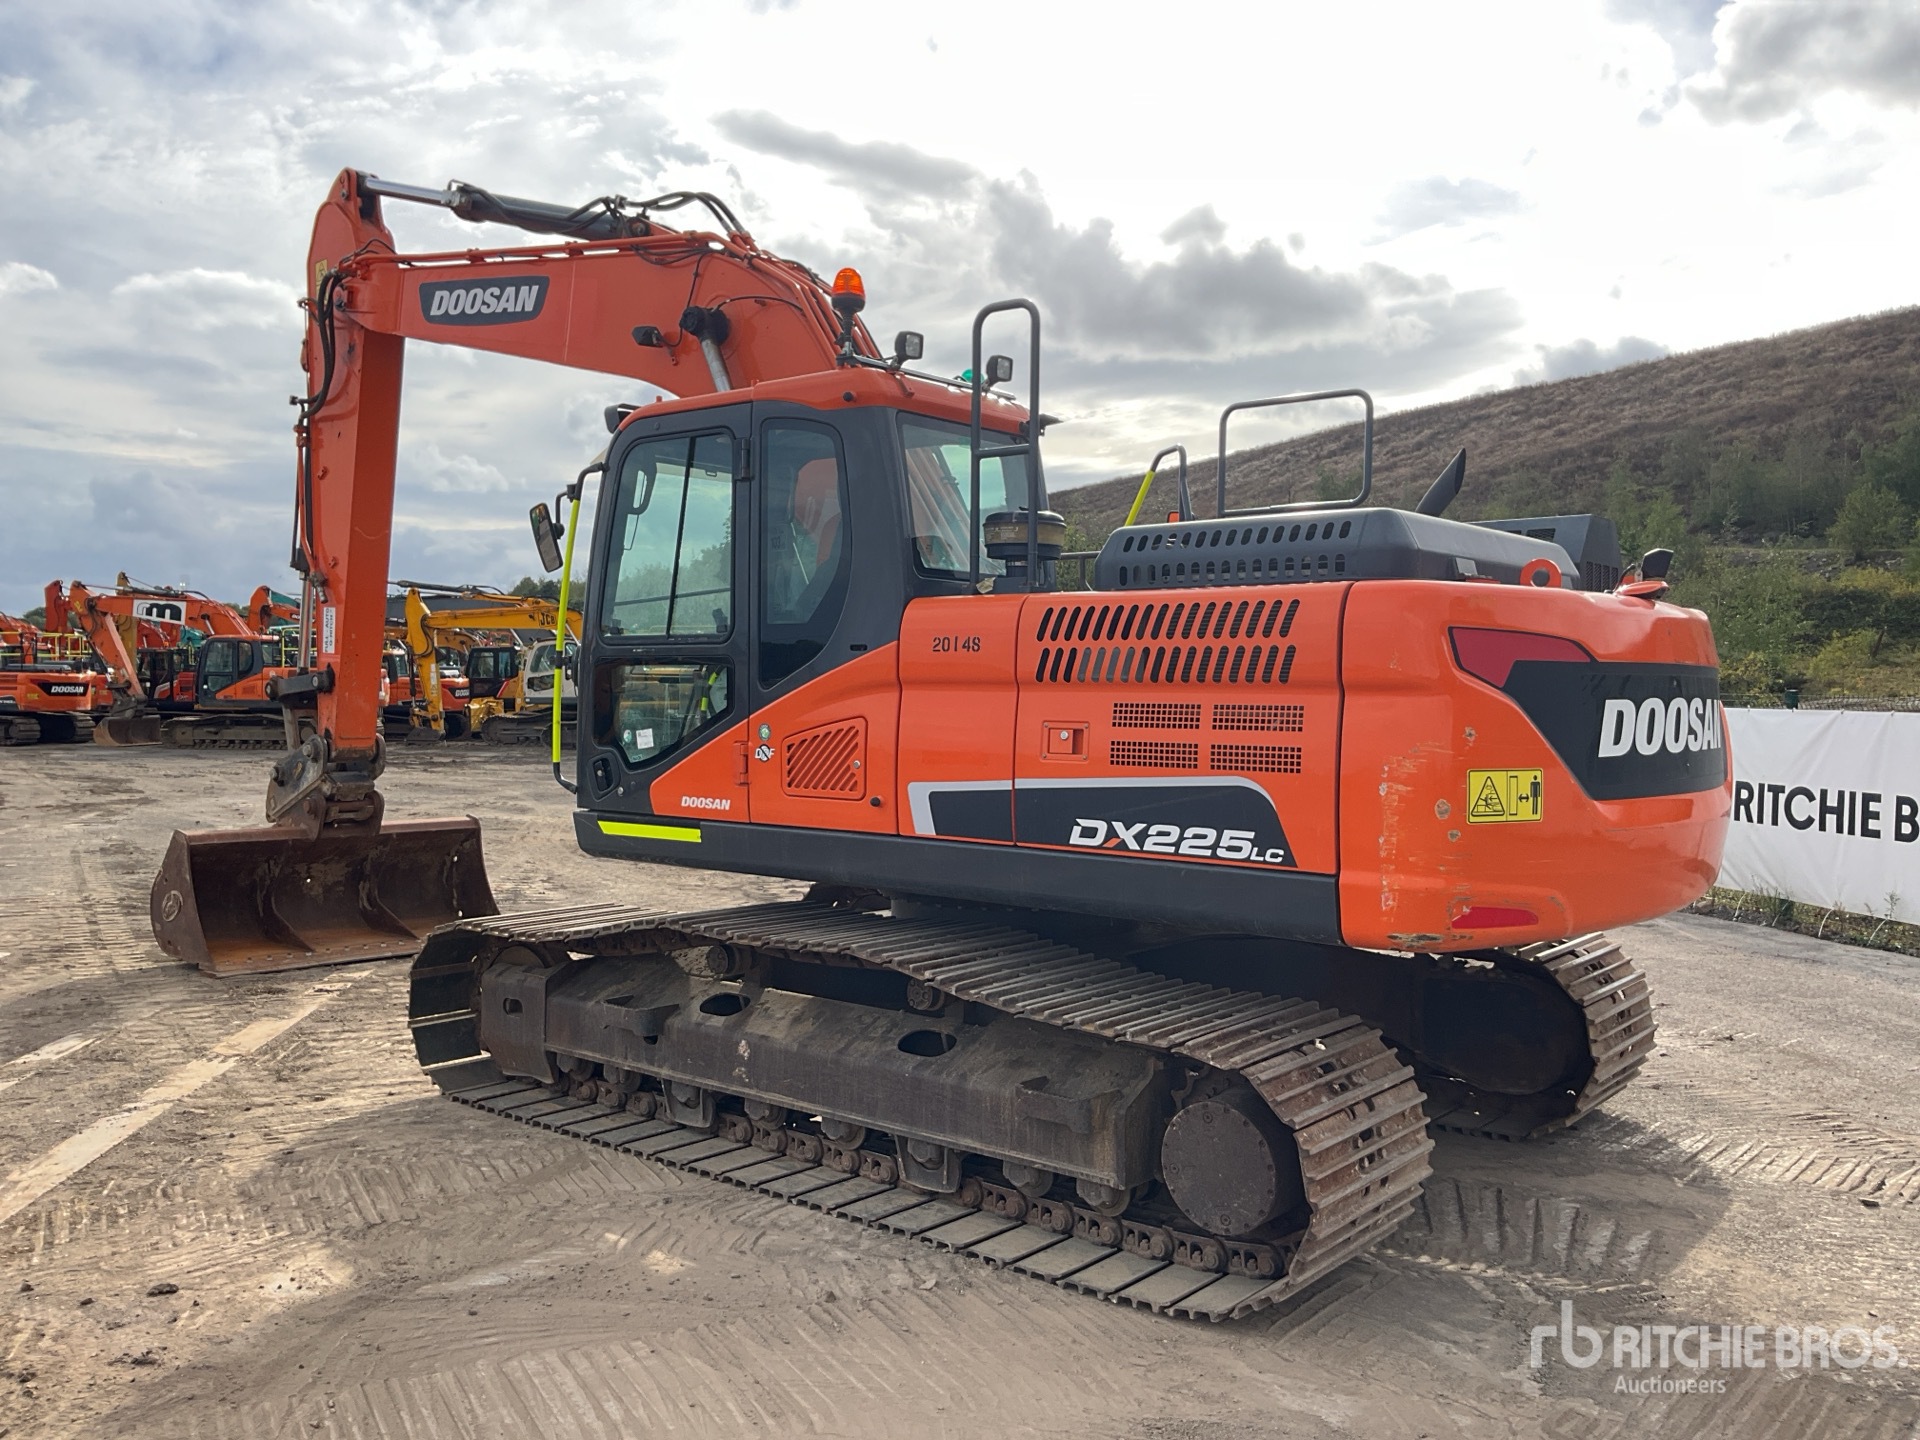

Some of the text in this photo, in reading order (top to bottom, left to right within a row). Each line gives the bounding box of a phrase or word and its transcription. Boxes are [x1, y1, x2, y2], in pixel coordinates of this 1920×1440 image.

[430, 285, 539, 315] DOOSAN
[540, 611, 556, 626] JCB
[51, 685, 84, 693] DOOSAN
[681, 795, 731, 811] DOOSAN
[1734, 780, 1920, 843] RITCHIE B
